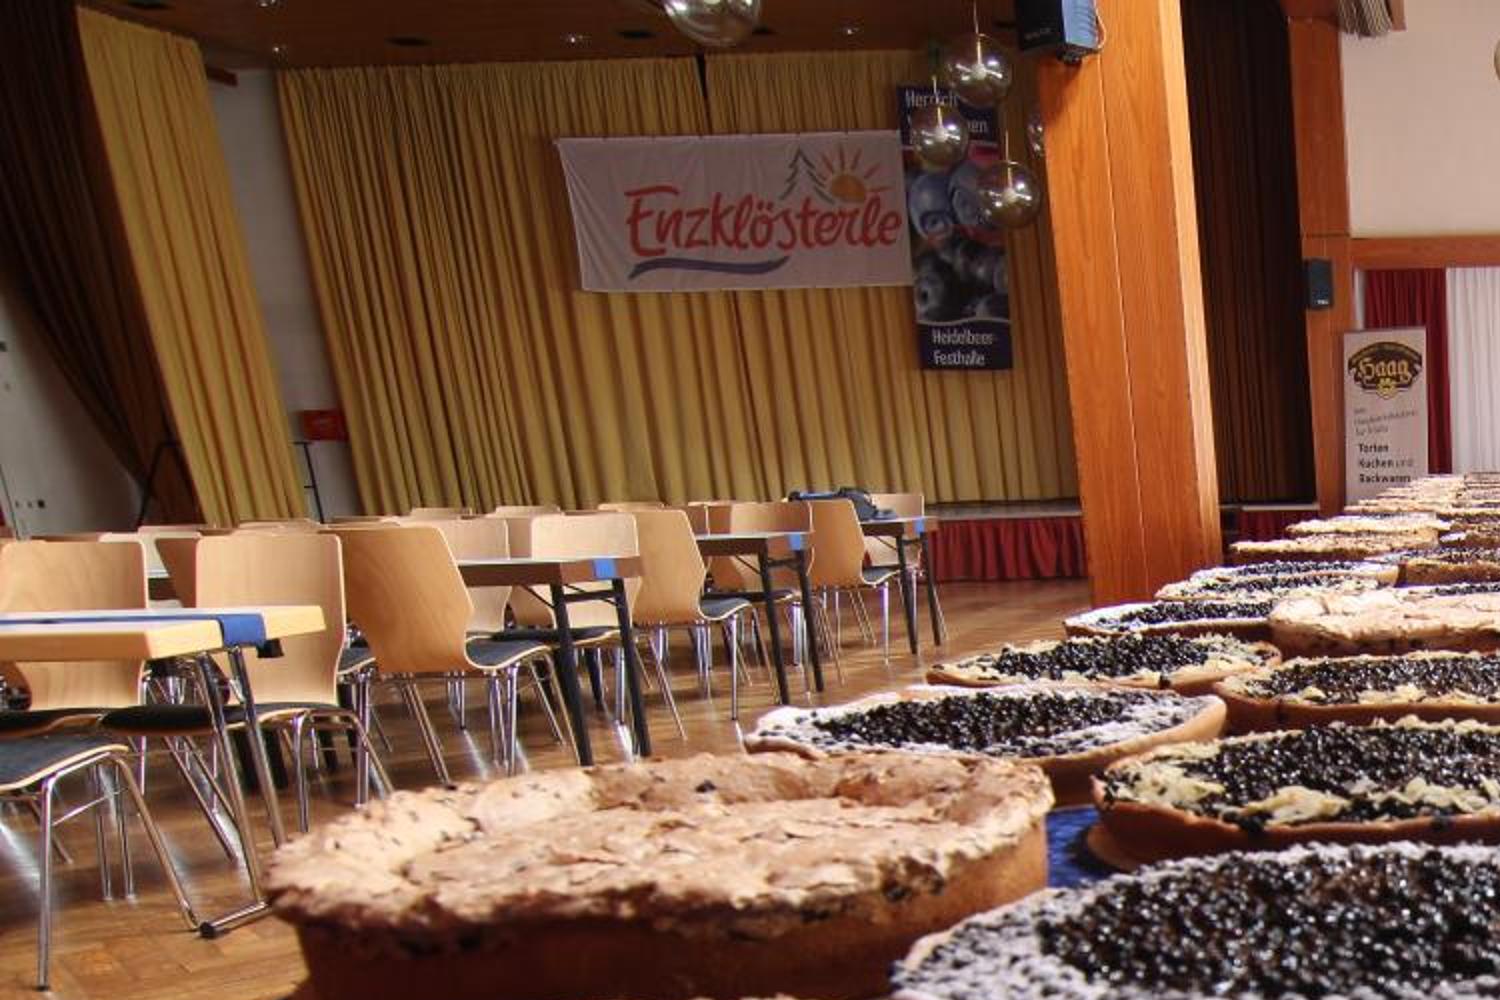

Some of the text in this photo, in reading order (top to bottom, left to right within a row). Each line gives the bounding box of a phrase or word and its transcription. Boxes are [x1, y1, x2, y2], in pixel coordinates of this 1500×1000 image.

[623, 184, 902, 257] Enzklösterle
[1357, 357, 1412, 385] Haag
[1359, 443, 1389, 453] Torten
[1359, 458, 1394, 468] Kuchen
